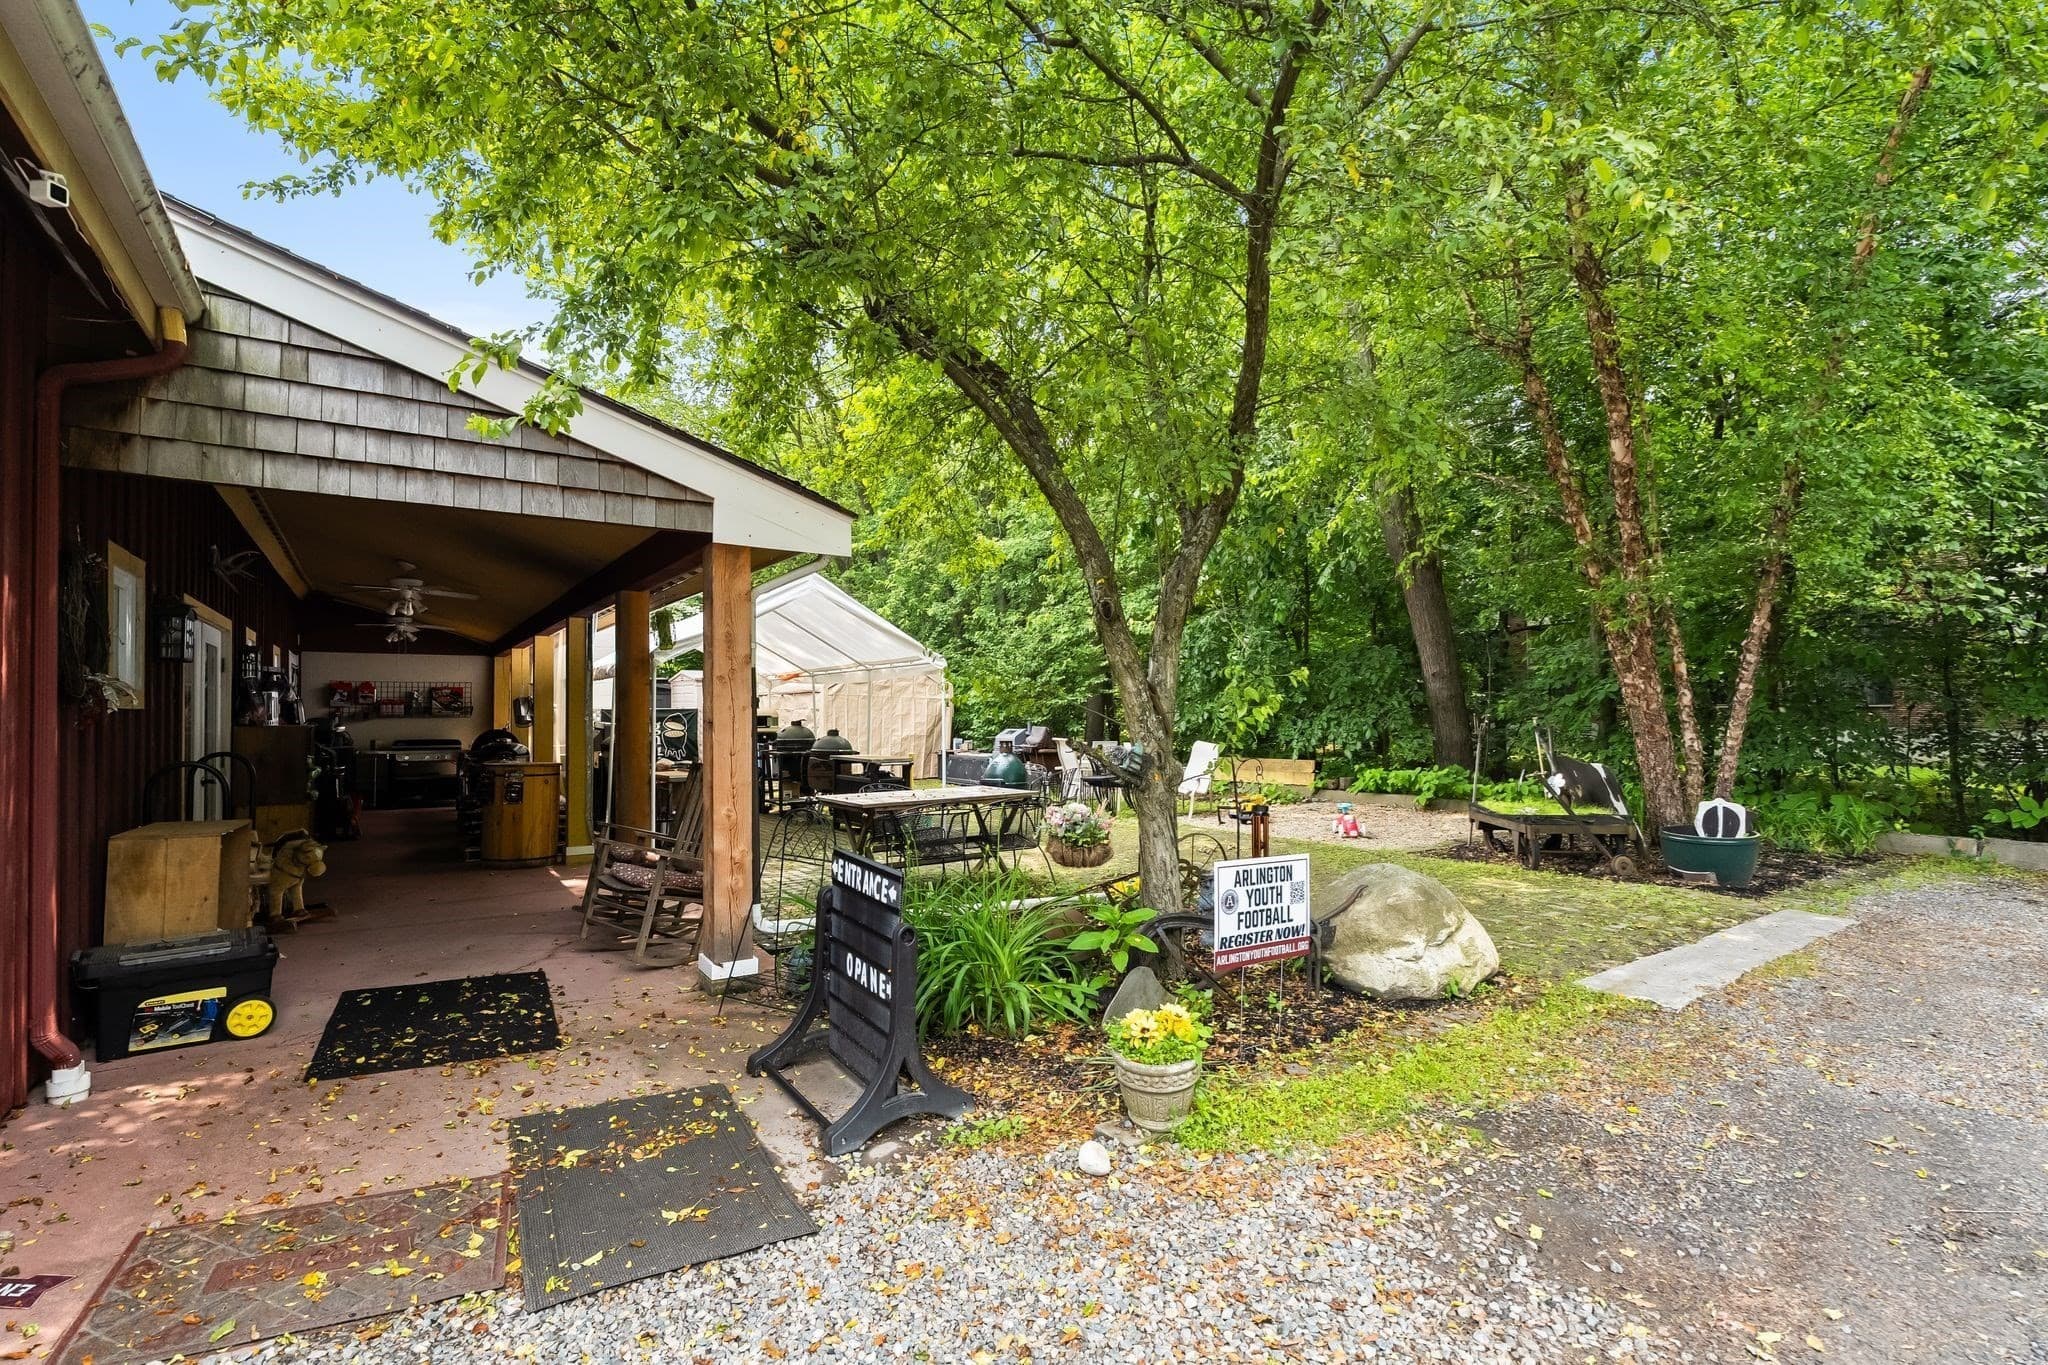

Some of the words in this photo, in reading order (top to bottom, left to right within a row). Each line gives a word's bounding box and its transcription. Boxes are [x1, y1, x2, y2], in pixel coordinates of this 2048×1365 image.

[837, 858, 889, 904] ENTRANCE
[1234, 865, 1293, 888] ARLINGTON
[1246, 885, 1283, 907] YOUTH
[1237, 905, 1294, 930] FOOTBALL
[1220, 930, 1274, 950] REGISTER
[1275, 924, 1306, 940] NOW!
[1216, 941, 1310, 967] ARLINGTONYOUTHFOOTBALL.ORG
[0, 1283, 37, 1297] EN
